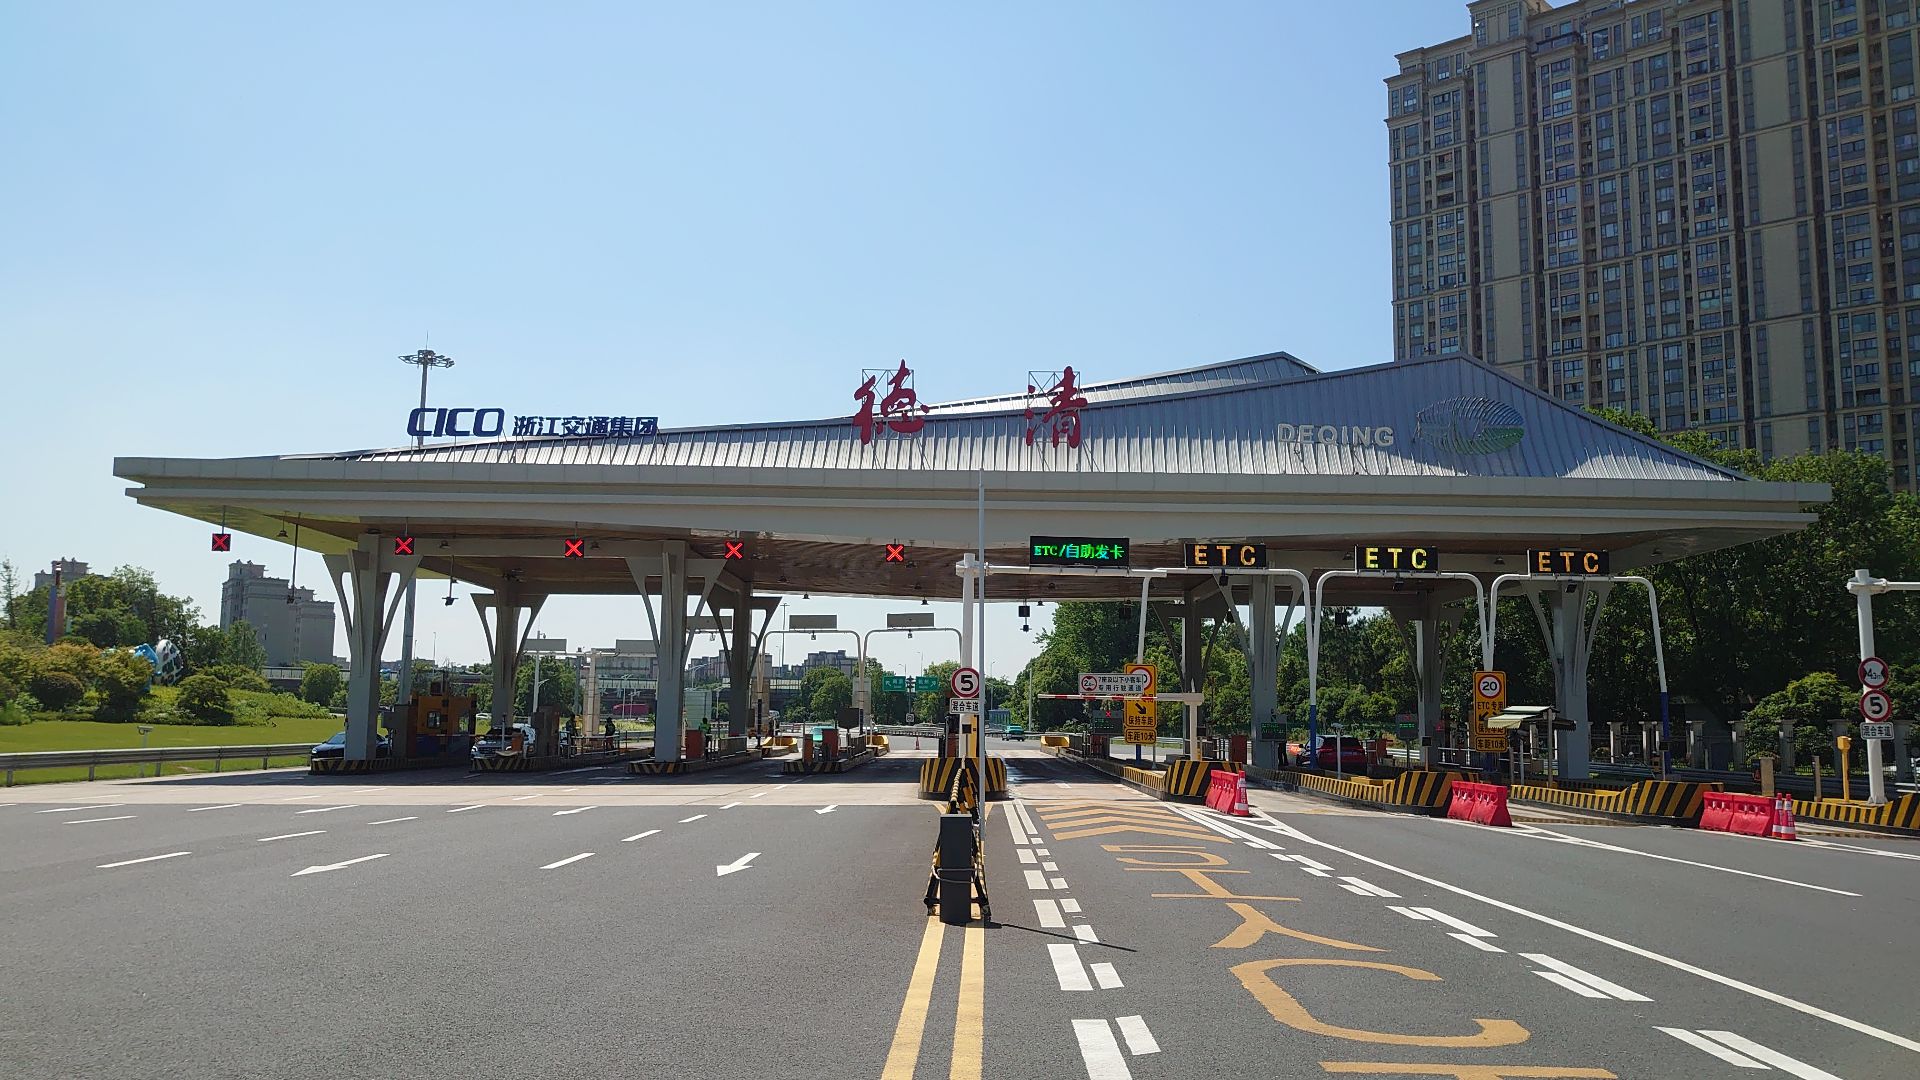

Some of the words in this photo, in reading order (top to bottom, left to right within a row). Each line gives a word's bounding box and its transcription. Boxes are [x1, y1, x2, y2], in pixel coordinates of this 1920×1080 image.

[407, 407, 505, 437] CICO
[512, 415, 659, 437] 浙江交通集团
[1277, 423, 1394, 447] DEQING
[1194, 544, 1256, 565] ETC
[1365, 547, 1427, 569] ETC
[1538, 551, 1600, 573] ETC
[961, 674, 973, 691] 5
[1482, 681, 1497, 691] 20
[1869, 697, 1883, 714] 5
